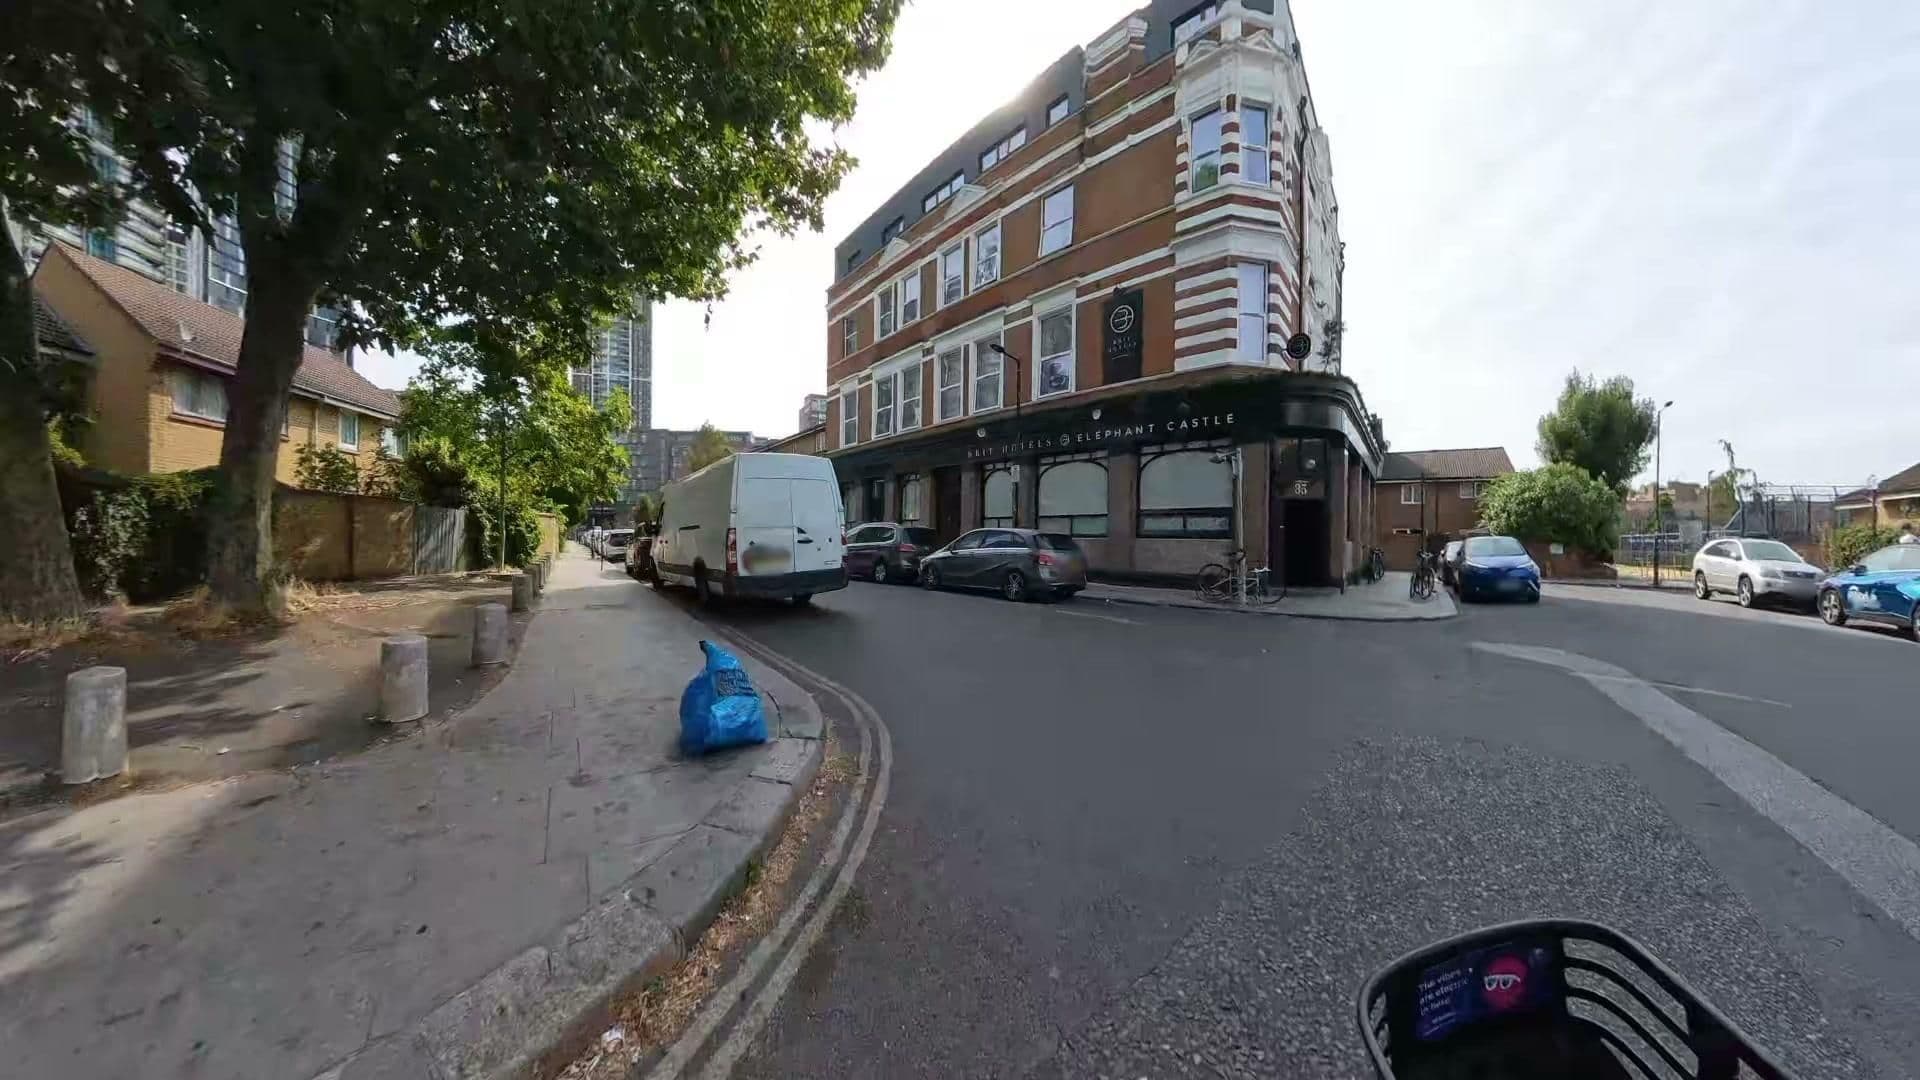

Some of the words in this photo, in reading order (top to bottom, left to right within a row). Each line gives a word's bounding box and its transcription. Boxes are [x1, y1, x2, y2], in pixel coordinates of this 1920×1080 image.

[1077, 423, 1155, 442] ELEPHANT
[1167, 413, 1235, 431] CASTLE
[1418, 979, 1436, 992] The
